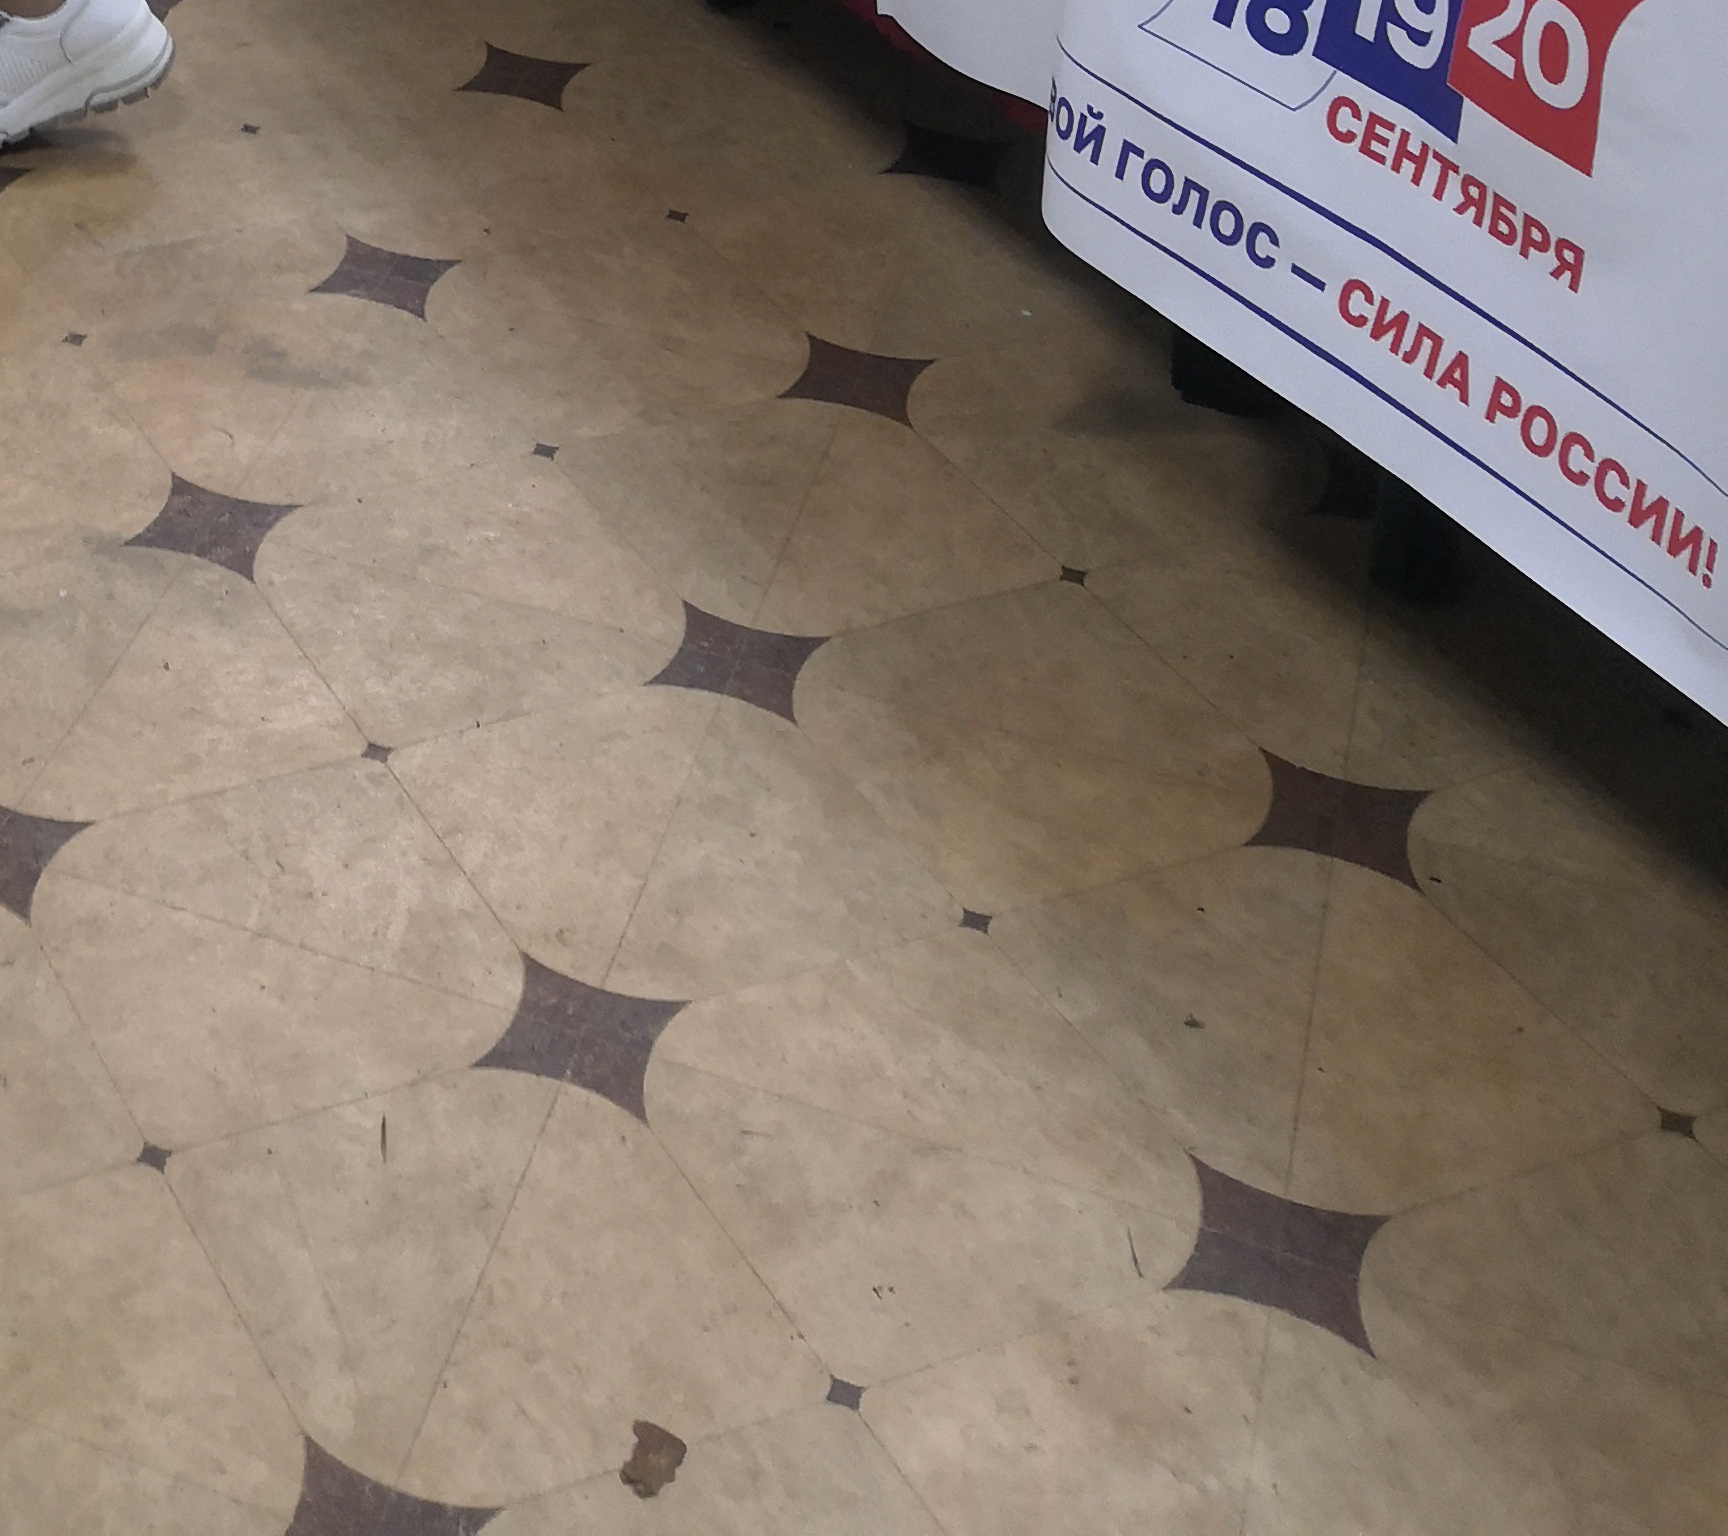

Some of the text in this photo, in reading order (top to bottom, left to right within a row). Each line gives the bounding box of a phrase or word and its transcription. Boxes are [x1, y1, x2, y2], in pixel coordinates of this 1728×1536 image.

[1325, 95, 1586, 295] СЕНТЯБРЯ
[1114, 137, 1281, 270] ГОЛОС
[1337, 278, 1470, 407] СИЛА
[1484, 376, 1719, 589] РОССИИ!
